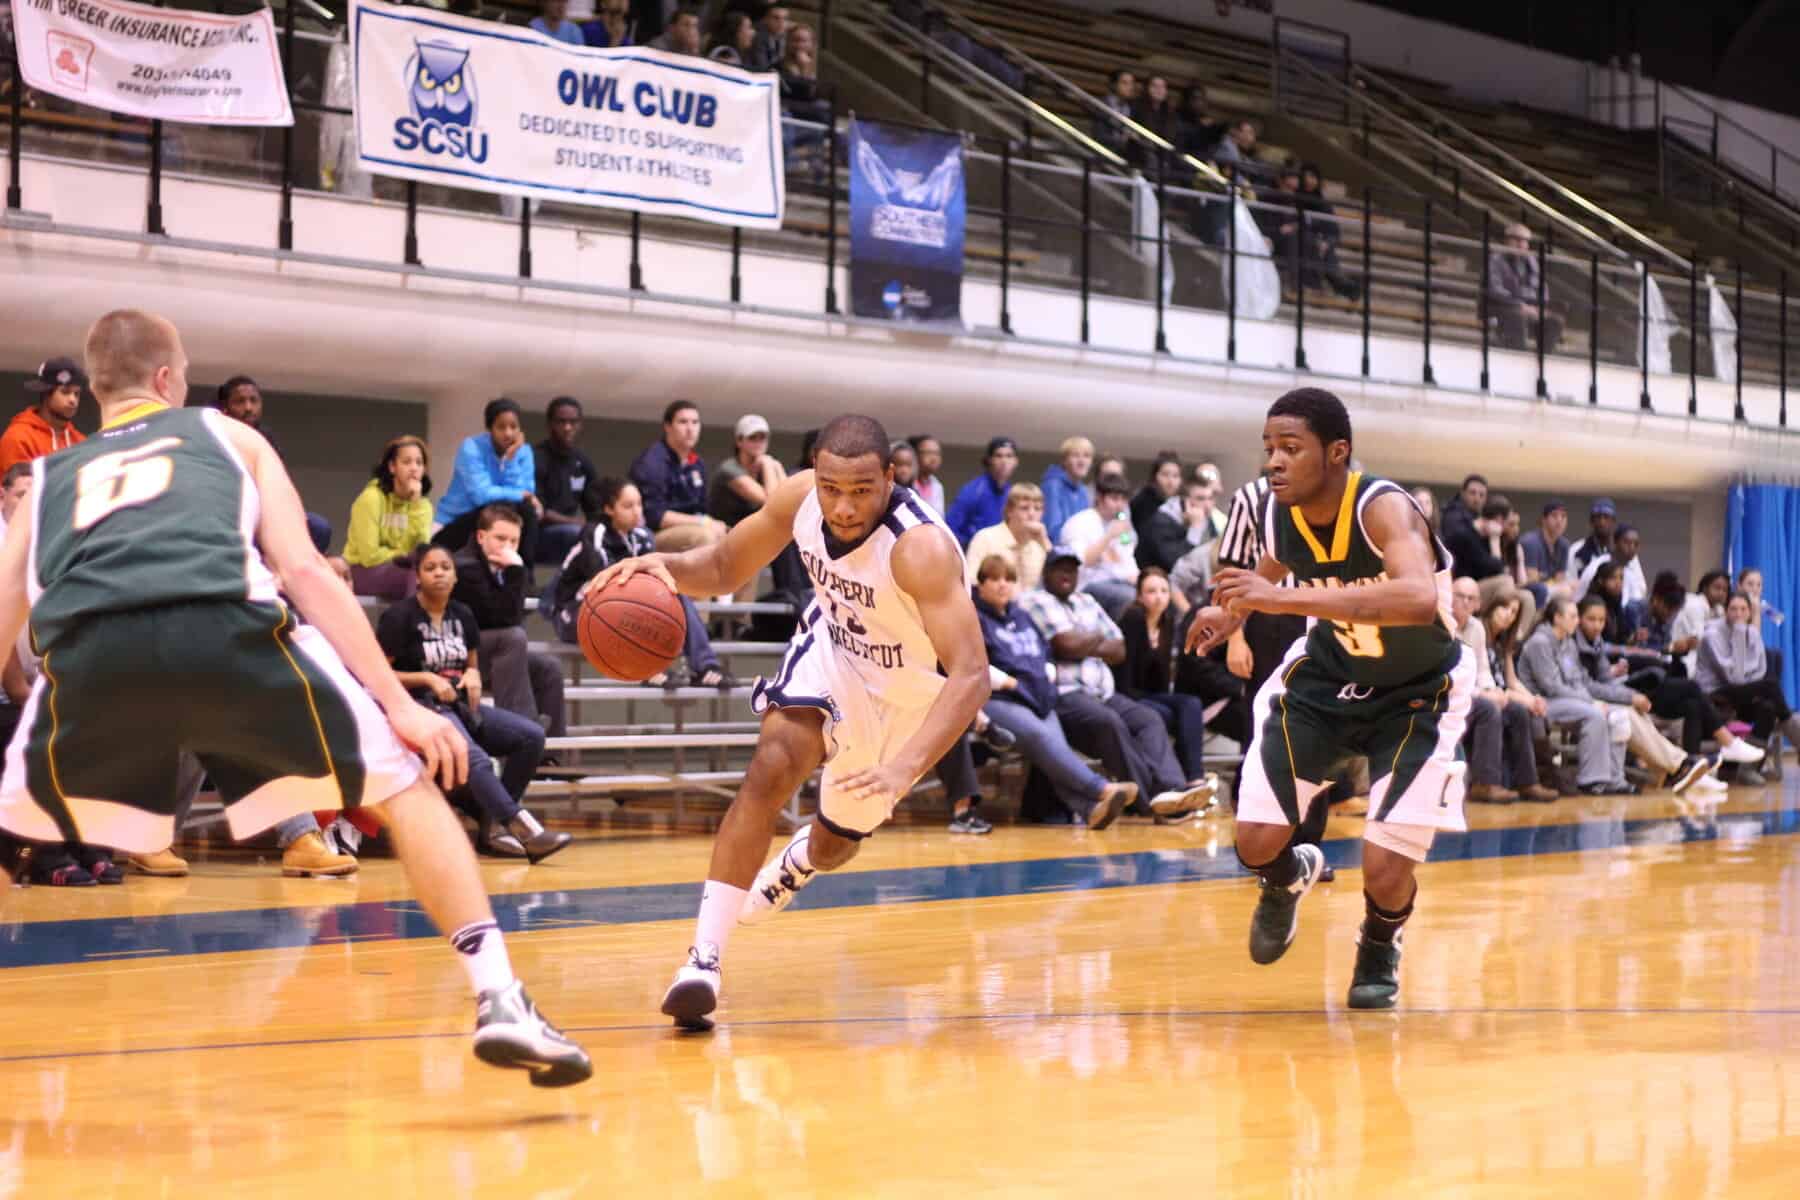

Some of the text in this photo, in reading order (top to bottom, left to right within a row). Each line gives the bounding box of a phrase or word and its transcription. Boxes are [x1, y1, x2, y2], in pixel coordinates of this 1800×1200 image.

[109, 15, 200, 49] INSURANCE
[558, 68, 718, 129] OWL CLUB
[393, 116, 488, 164] SCSU
[518, 112, 614, 142] DEDICATED
[619, 127, 641, 147] TO
[73, 436, 184, 530] 5
[801, 550, 877, 610] SOUHERN
